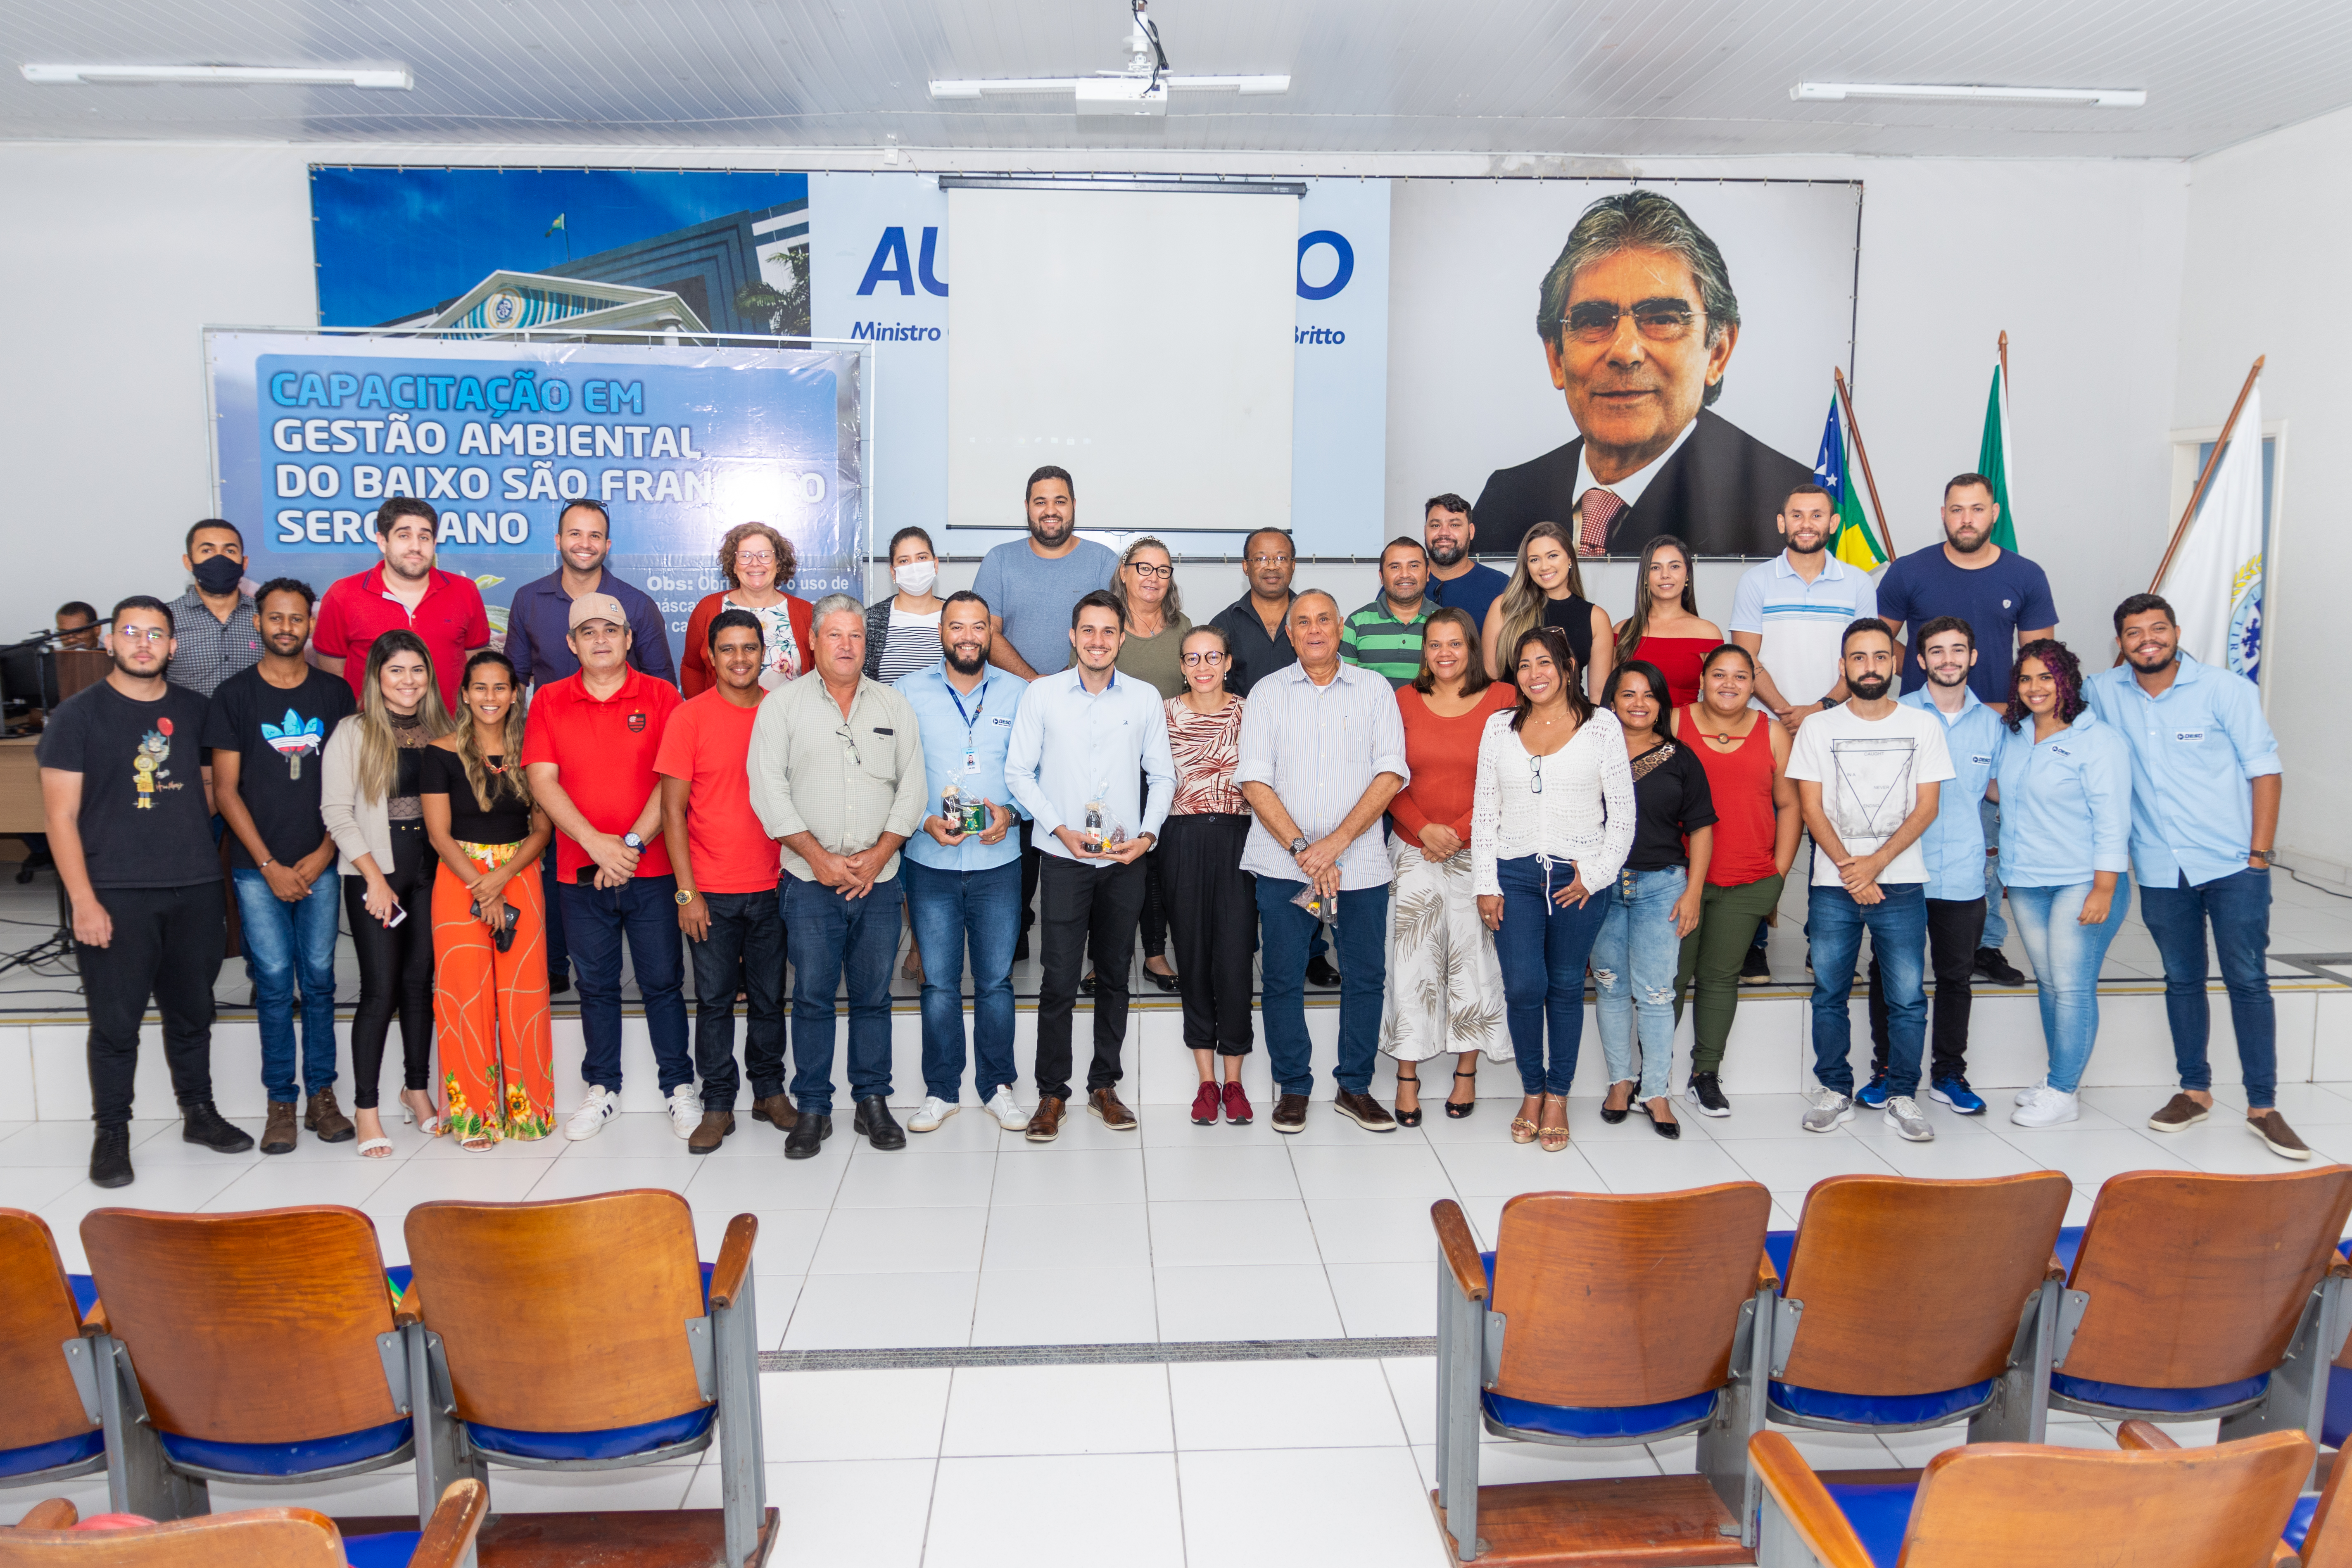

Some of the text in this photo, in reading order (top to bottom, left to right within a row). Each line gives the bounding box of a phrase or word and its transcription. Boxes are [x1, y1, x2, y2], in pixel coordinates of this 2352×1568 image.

[851, 321, 941, 341] Ministro
[271, 371, 642, 418] CAPACITAÇÃO EM
[273, 413, 702, 459] GESTÃO AMBIENTAL
[276, 461, 825, 503] DO BAIXO SÃO FRANO
[277, 510, 528, 544] SERANO
[646, 576, 694, 591] Obs:
[800, 579, 827, 590] uso
[831, 575, 849, 590] de
